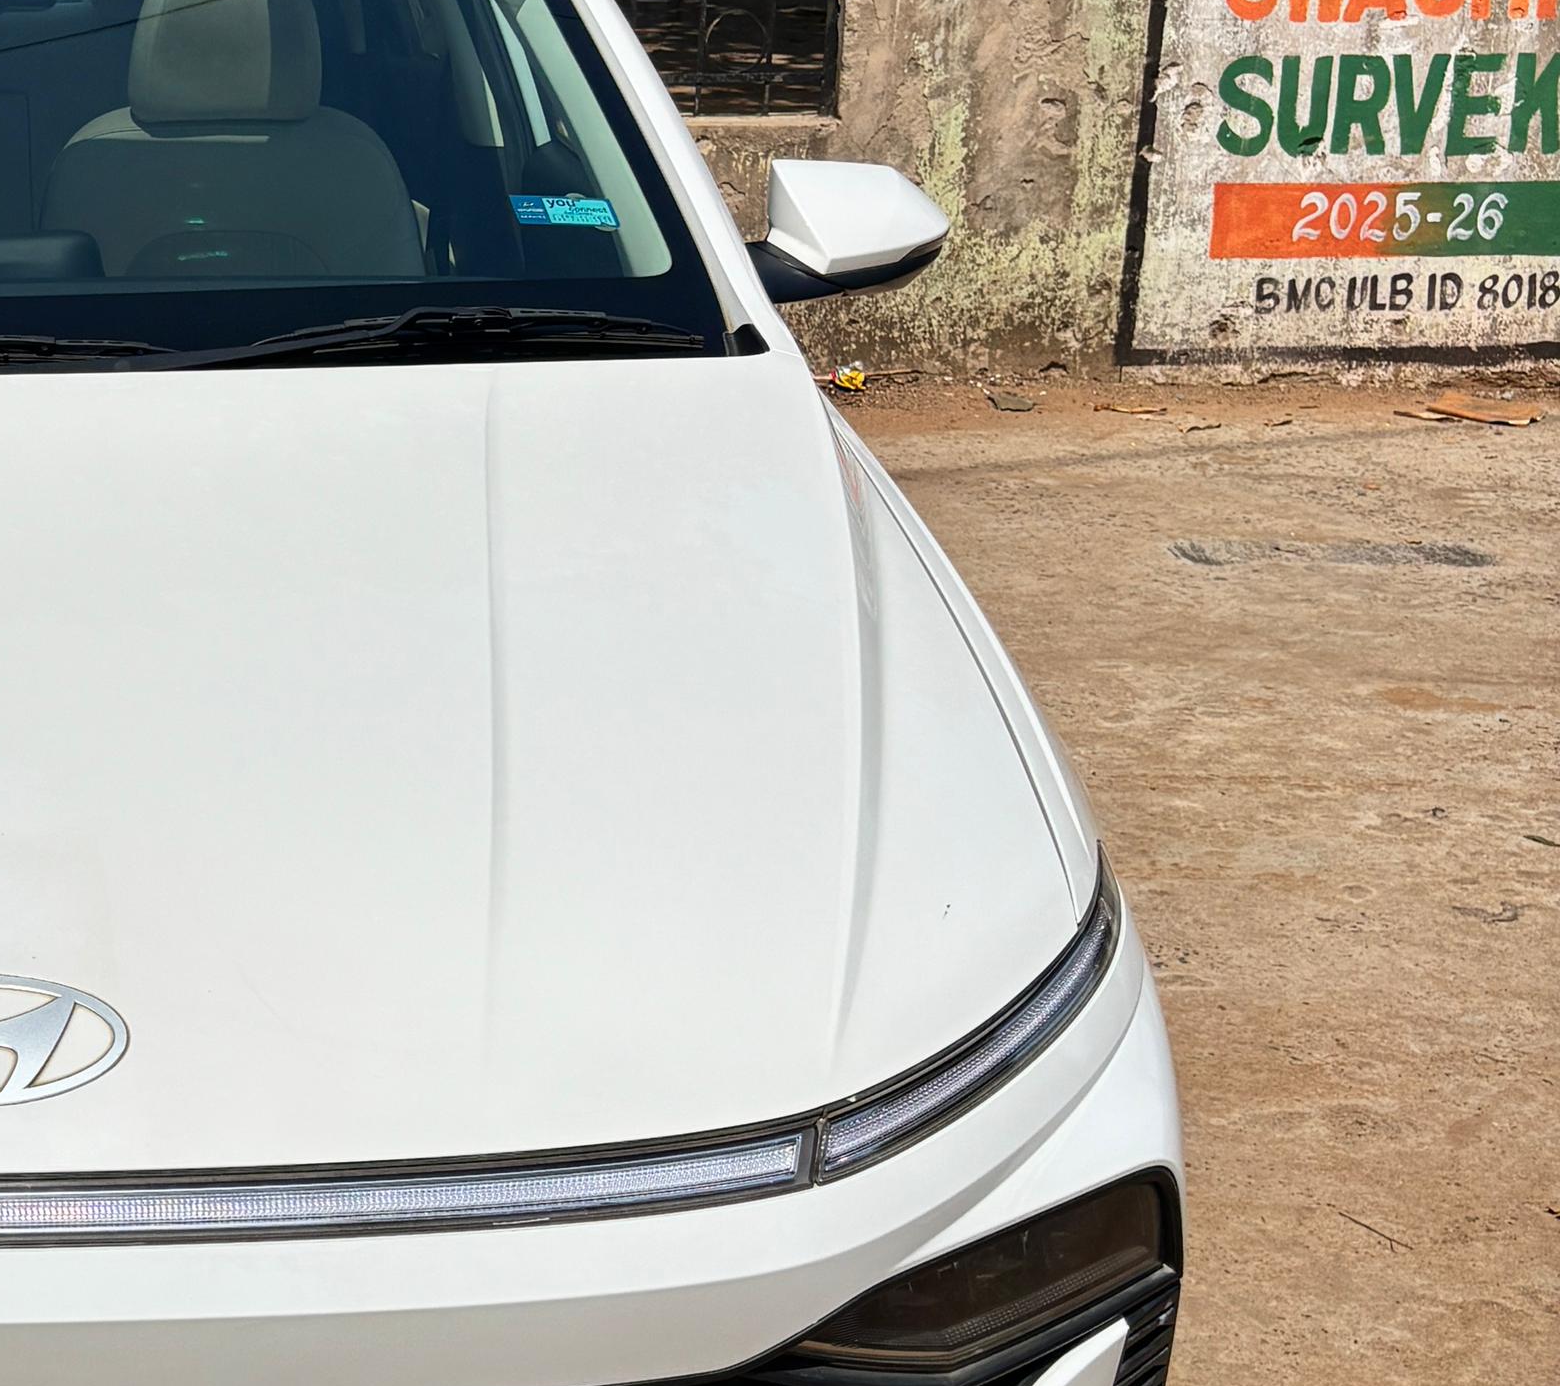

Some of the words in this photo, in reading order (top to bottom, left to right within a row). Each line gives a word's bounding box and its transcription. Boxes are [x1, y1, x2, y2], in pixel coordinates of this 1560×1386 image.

[1216, 51, 1560, 158] SURVEK
[1292, 191, 1509, 243] 2025-26
[1254, 276, 1337, 314] BMC
[1345, 272, 1415, 312] ULB
[1426, 272, 1464, 312] ID
[1476, 270, 1560, 311] 8018
